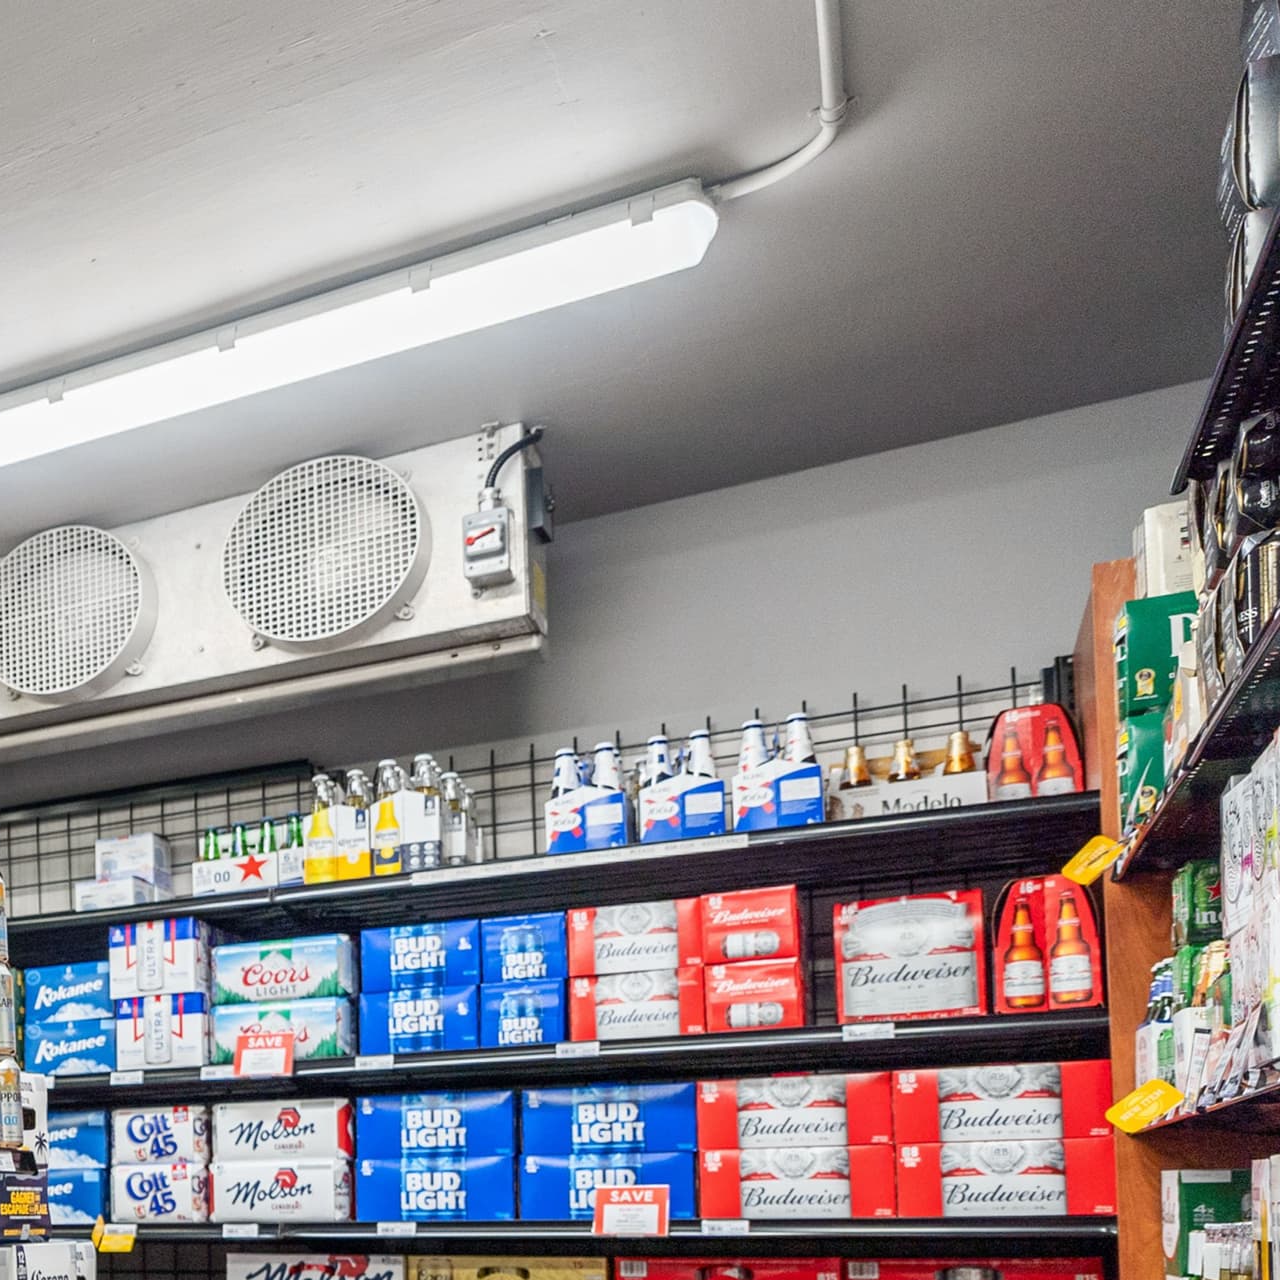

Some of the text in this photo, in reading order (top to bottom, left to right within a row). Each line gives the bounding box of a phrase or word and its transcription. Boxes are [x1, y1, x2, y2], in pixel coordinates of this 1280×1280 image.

[147, 938, 156, 978] ULTRA
[394, 936, 442, 956] BUD
[595, 937, 679, 963] Budweiser
[390, 948, 445, 970] LIGHT
[241, 963, 311, 992] Coors
[848, 959, 972, 988] Budweiser
[35, 977, 104, 1011] Kokanee
[256, 983, 299, 997] LIGHT
[247, 1035, 283, 1050] SAVE
[128, 1113, 170, 1146] Colt
[406, 1109, 462, 1130] BUD
[942, 1106, 1064, 1130] Budweiser
[231, 1111, 318, 1154] Molson
[402, 1124, 467, 1149] LIGHT
[148, 1131, 180, 1161] 45
[610, 1190, 654, 1204] SAVE
